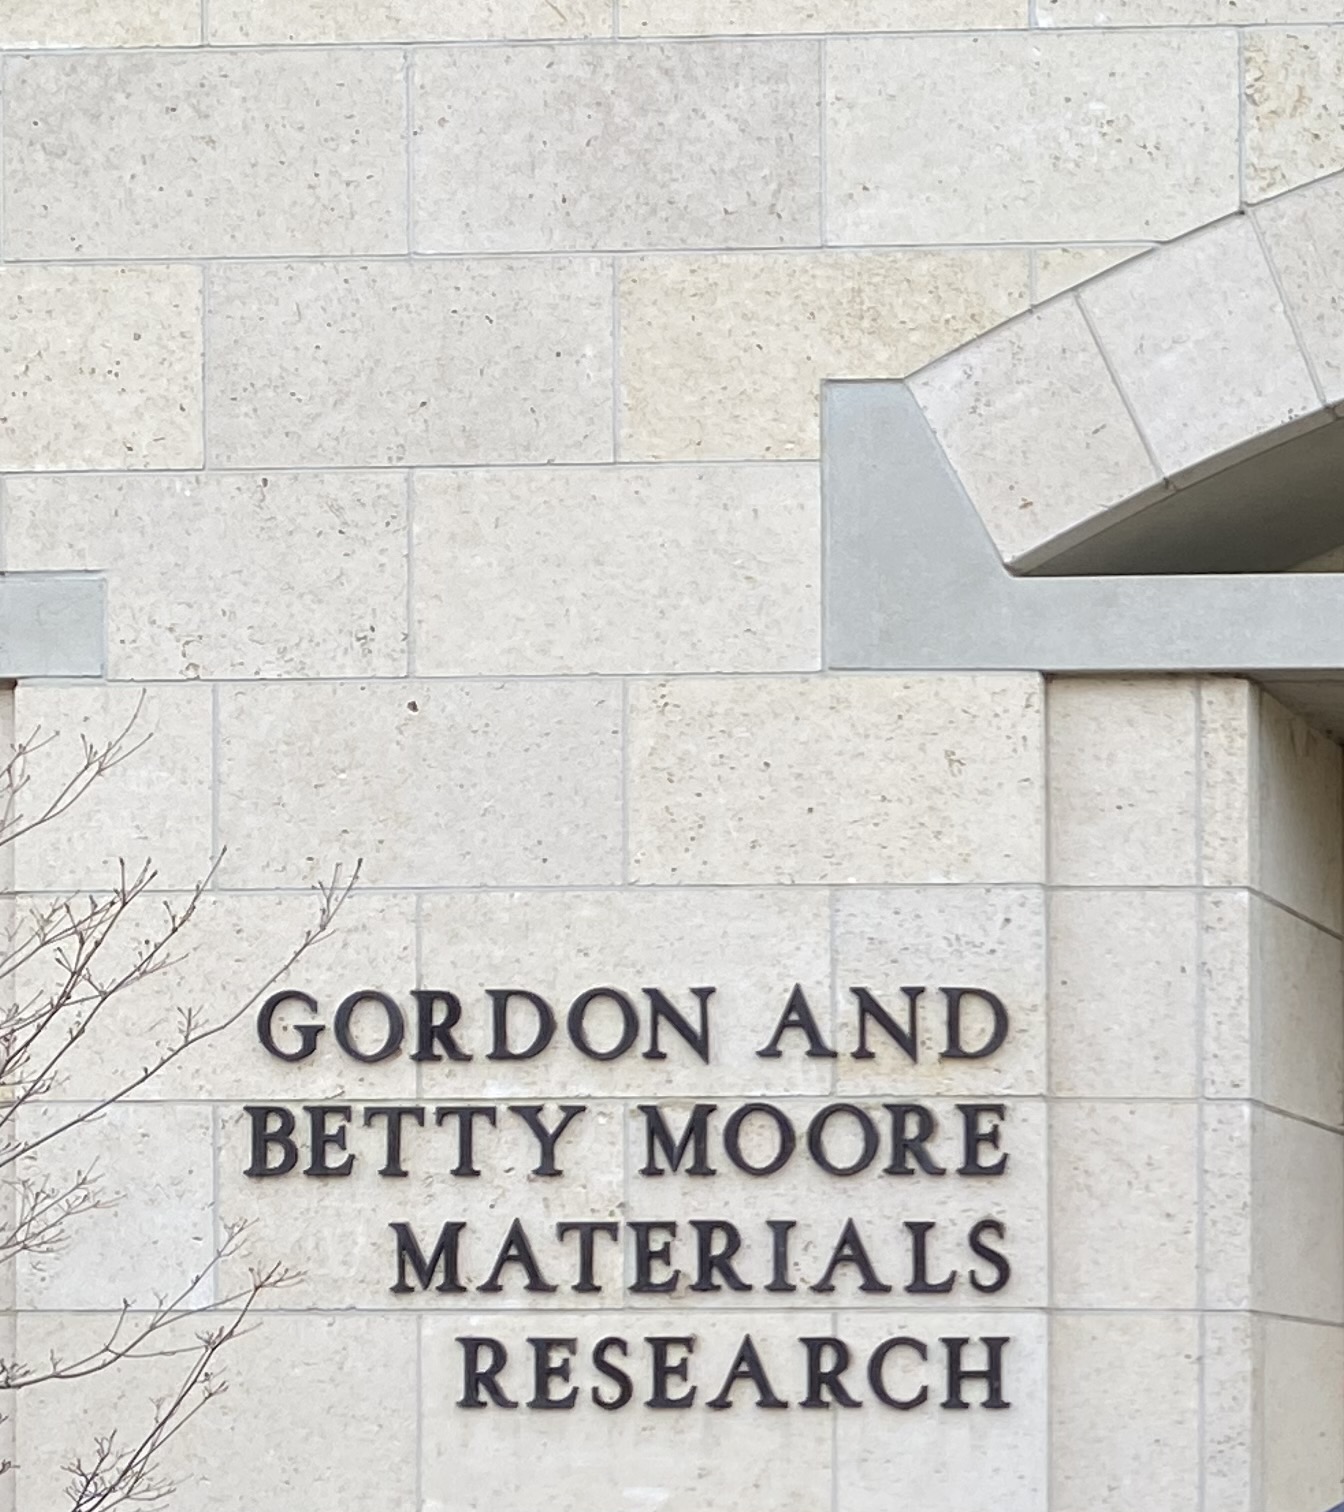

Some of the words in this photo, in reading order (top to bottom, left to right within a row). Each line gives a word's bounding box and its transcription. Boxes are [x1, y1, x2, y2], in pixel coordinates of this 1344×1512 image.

[256, 987, 717, 1064] GORDON
[756, 984, 1010, 1063] AND
[242, 1104, 587, 1179] BETTY
[637, 1102, 1010, 1177] MOORE
[389, 1218, 1011, 1294] MATERIALS
[456, 1335, 1011, 1411] RESEARCH
